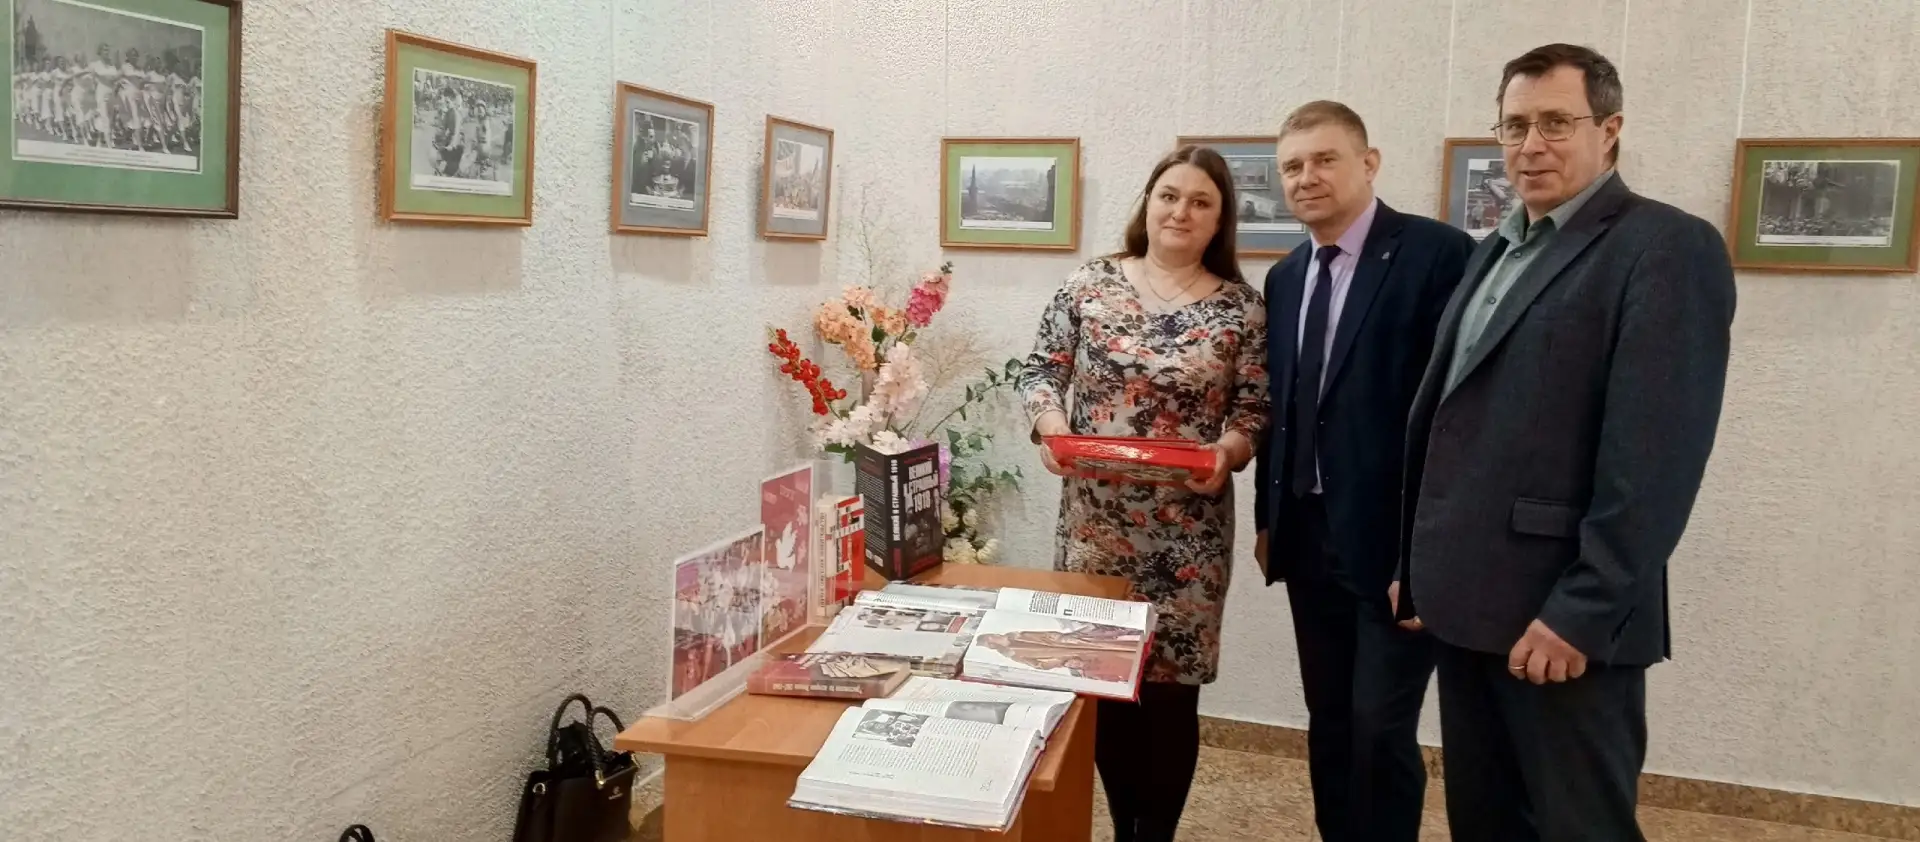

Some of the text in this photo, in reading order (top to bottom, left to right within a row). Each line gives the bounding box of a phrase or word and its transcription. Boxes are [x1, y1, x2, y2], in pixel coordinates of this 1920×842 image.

[908, 457, 933, 480] ВЕЛИКИЙ
[890, 475, 900, 509] СТРАШНЫЙ
[908, 469, 939, 494] СТРАШНЫЙ
[913, 489, 931, 513] 1918
[891, 515, 900, 541] ВЕЛИКИЙ
